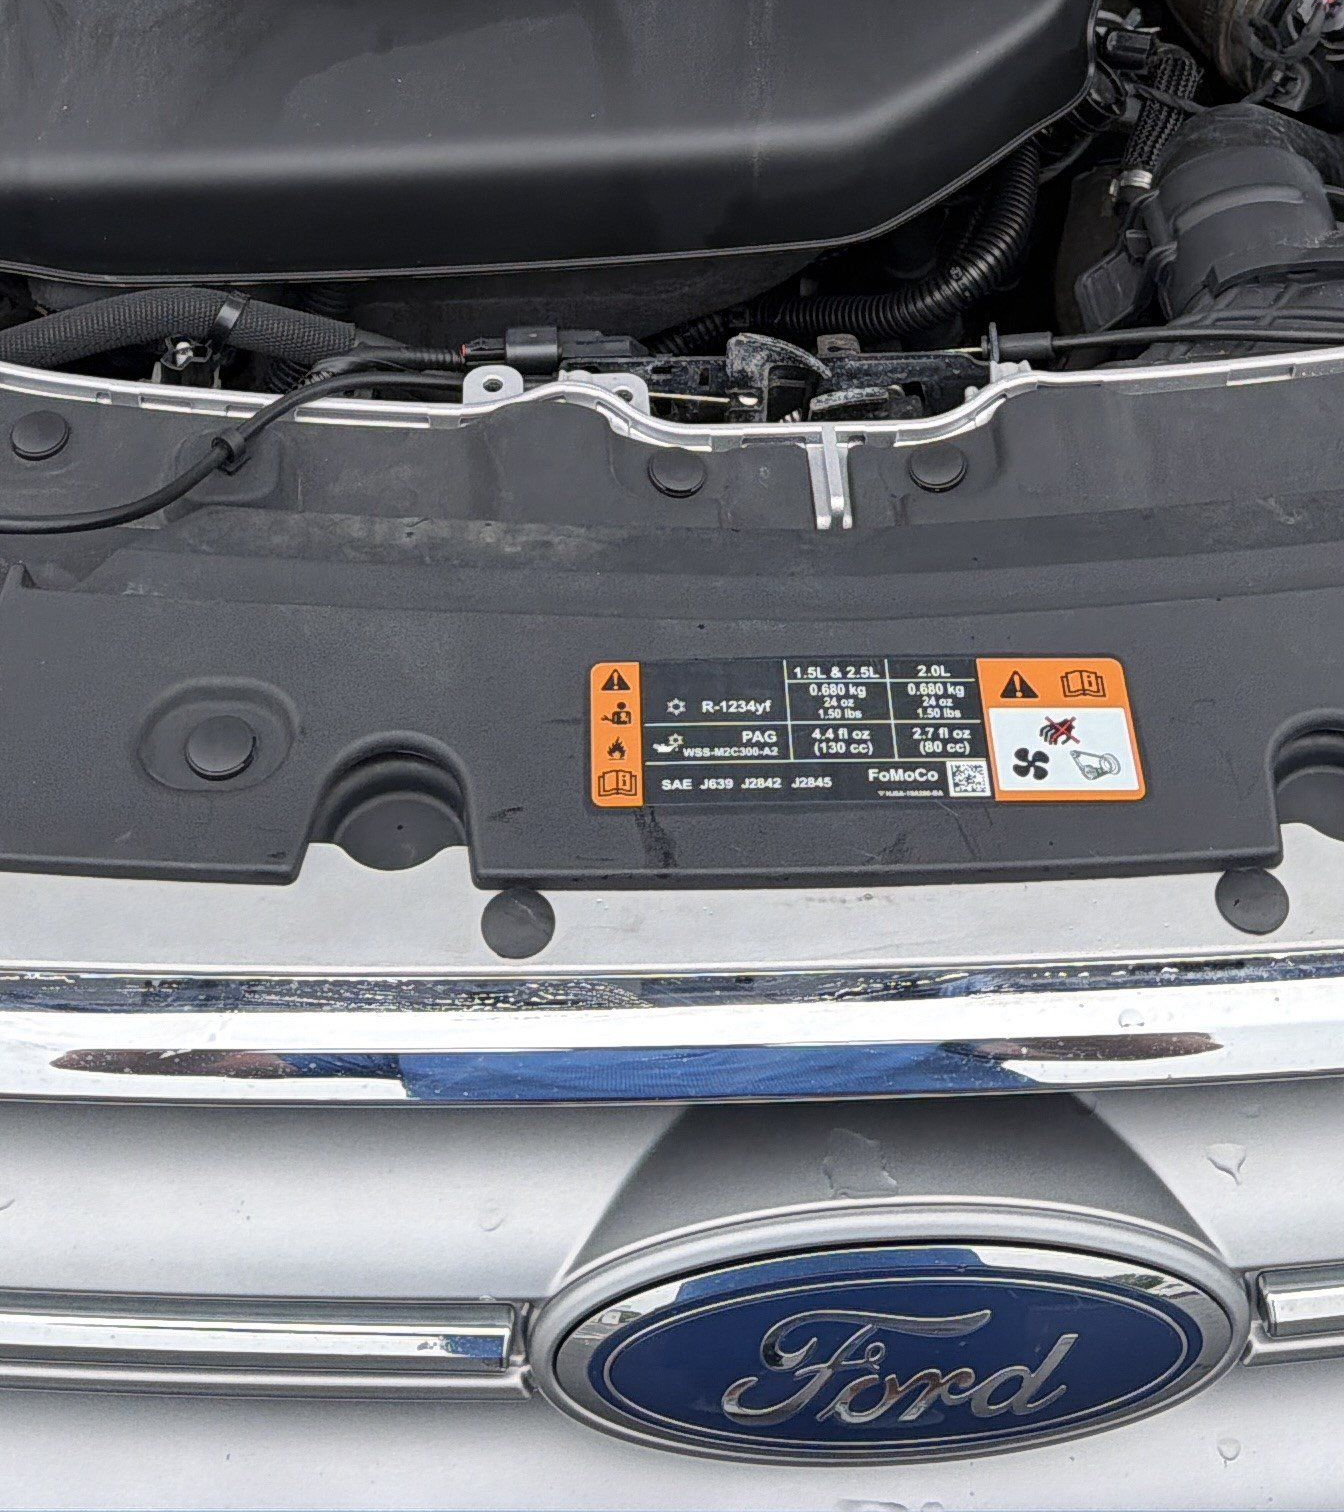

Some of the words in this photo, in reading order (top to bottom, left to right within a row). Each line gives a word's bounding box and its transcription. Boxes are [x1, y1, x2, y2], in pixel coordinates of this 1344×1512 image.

[794, 666, 827, 679] 1.5L
[830, 666, 843, 678] &
[846, 665, 880, 678] 2.5L
[917, 664, 951, 677] 2.0L
[809, 683, 846, 696] 0.680
[849, 684, 867, 698] kg
[907, 683, 944, 695] 0.680
[948, 683, 965, 698] kg
[701, 699, 772, 715] R-1234yf
[823, 697, 838, 707] 24
[840, 699, 855, 707] oz
[922, 696, 937, 706] 24
[939, 698, 953, 706] oz
[818, 709, 842, 719] 1.50
[844, 709, 862, 718] lbs
[917, 709, 941, 718] 1.50
[943, 708, 961, 718] lbs
[742, 730, 777, 743] PAG
[811, 728, 835, 740] 4.4
[837, 727, 848, 739] fl
[852, 730, 871, 739] oz
[912, 727, 935, 739] 2.7
[938, 727, 949, 739] fl
[953, 729, 971, 739] oz
[814, 741, 846, 756] (130
[849, 741, 874, 756] cc)
[919, 740, 943, 755] (80
[946, 740, 970, 755] cc)
[868, 768, 939, 782] FoMoCo
[661, 779, 693, 790] SAE
[700, 778, 734, 790] J639
[721, 1308, 1080, 1423] Ford
